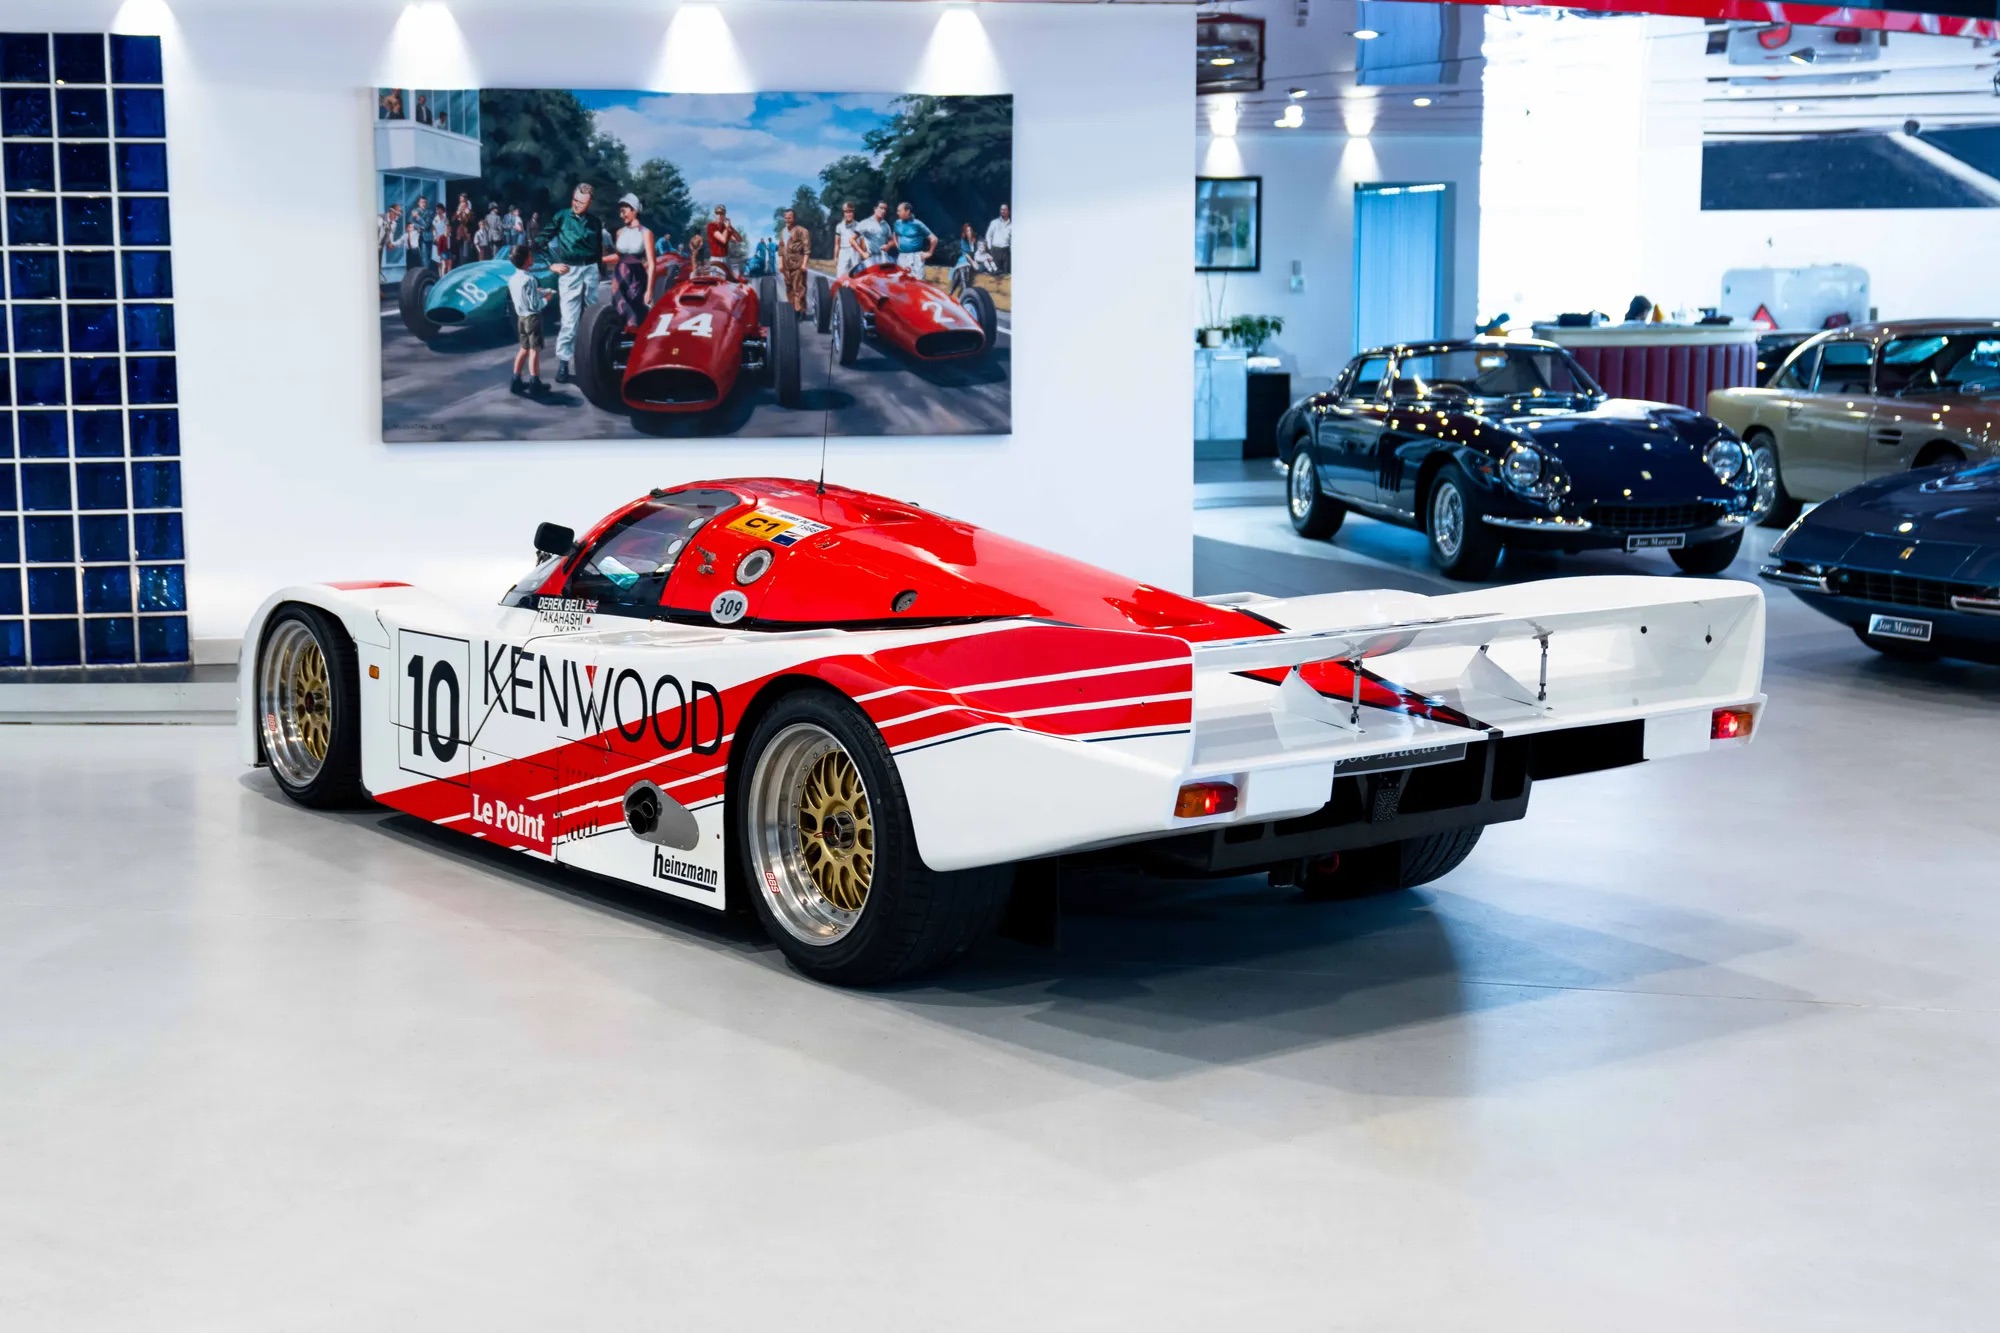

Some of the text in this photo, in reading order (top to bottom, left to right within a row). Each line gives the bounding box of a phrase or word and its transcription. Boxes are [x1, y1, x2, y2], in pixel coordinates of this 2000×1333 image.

[456, 282, 488, 305] 18
[921, 301, 955, 323] 2
[646, 312, 713, 339] 14
[745, 517, 780, 532] C1
[537, 596, 585, 612] DEREK BELL
[716, 597, 743, 617] 309
[540, 611, 584, 626] TAKAHASHI
[1877, 619, 1924, 636] Joe Macari
[407, 654, 460, 763] 10
[483, 639, 725, 757] KENWOOD
[472, 793, 545, 842] Le Point
[653, 845, 718, 891] heinzmann
[765, 871, 781, 893] BBS
